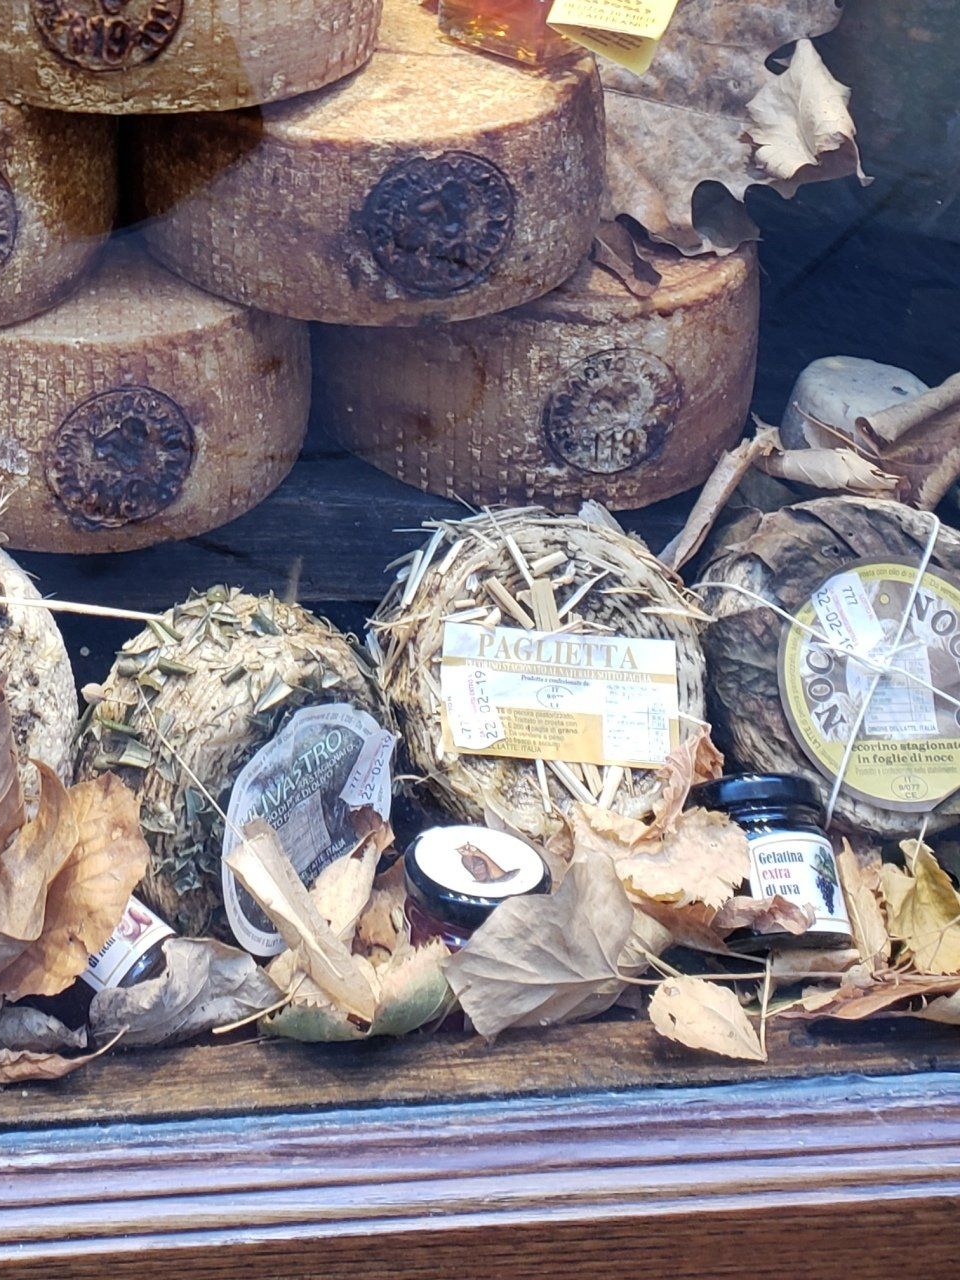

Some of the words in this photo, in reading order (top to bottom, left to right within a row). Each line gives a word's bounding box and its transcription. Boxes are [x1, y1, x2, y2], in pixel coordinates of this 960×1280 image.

[842, 584, 859, 605] 777
[478, 632, 639, 670] PAGLIETTA
[805, 633, 847, 736] NOC
[844, 741, 898, 753] ecorino
[900, 741, 960, 752] stagionat
[858, 754, 870, 764] in
[873, 753, 908, 766] foglie
[910, 753, 922, 762] di
[925, 754, 954, 762] noce
[361, 735, 392, 800] 22-02-19
[905, 791, 917, 799] CE
[757, 850, 804, 865] Gelatina
[761, 867, 792, 880] extra
[765, 884, 777, 897] di
[780, 884, 801, 895] uva
